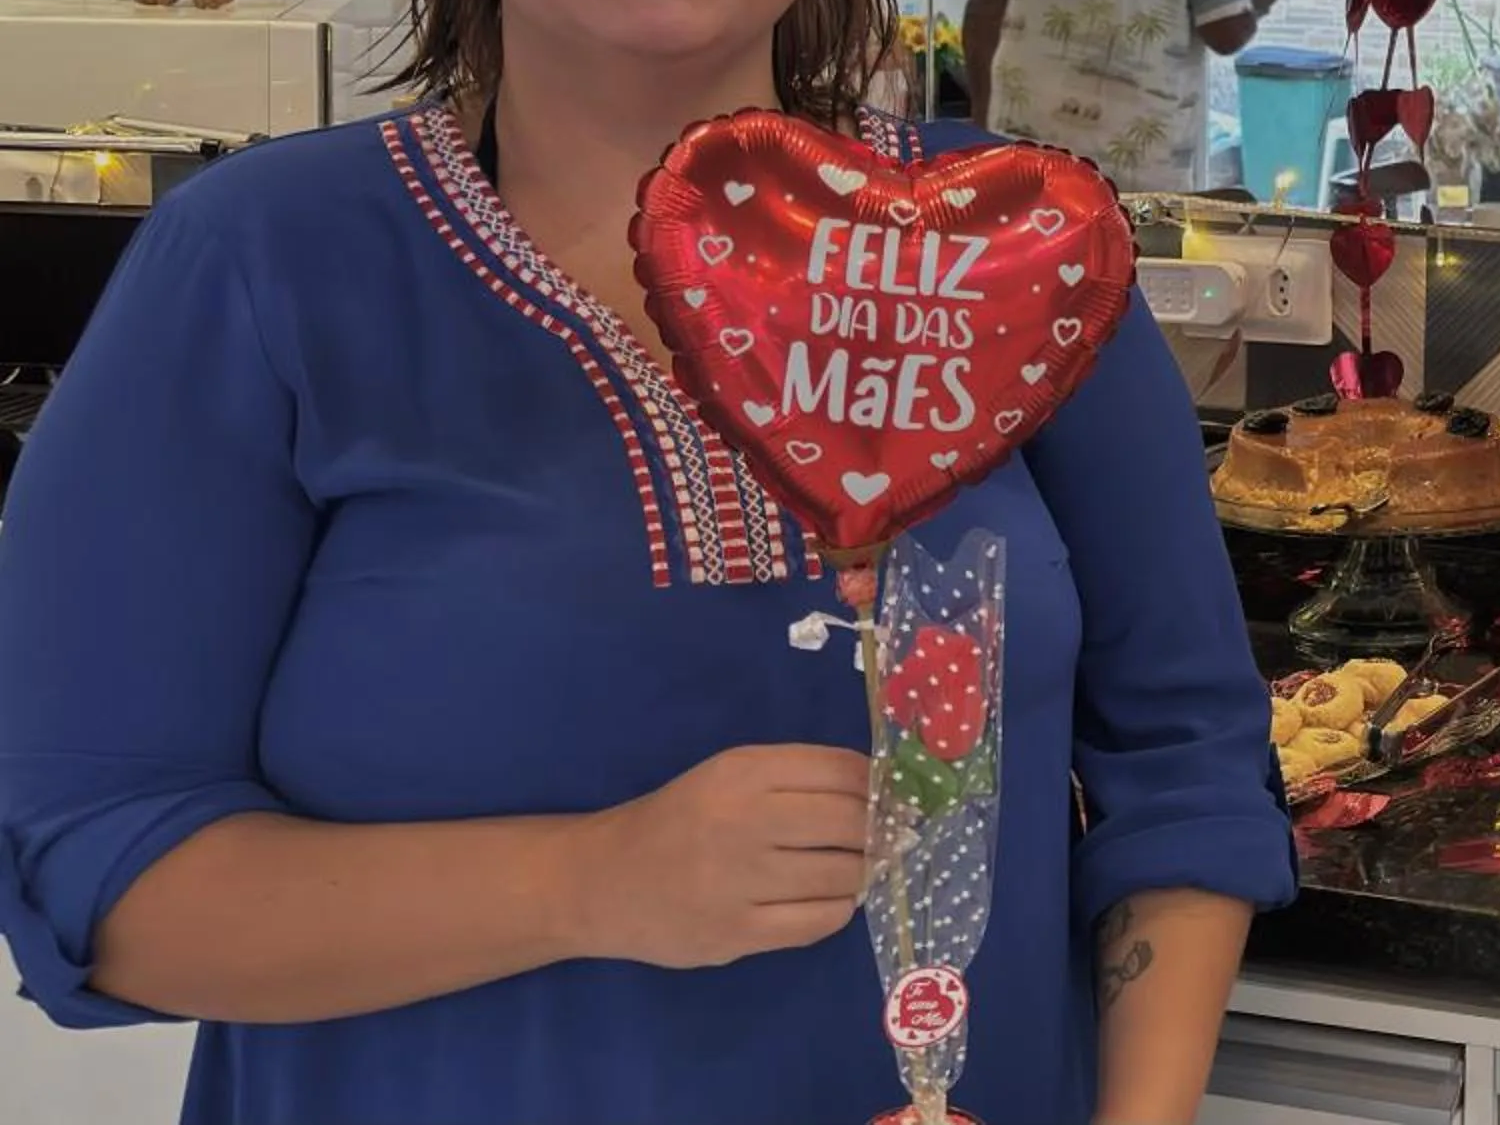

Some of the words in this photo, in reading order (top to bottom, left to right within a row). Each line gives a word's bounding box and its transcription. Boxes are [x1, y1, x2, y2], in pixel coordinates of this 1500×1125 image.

[806, 217, 990, 301] FELIZ
[809, 292, 877, 341] DIA
[894, 303, 975, 349] DAS
